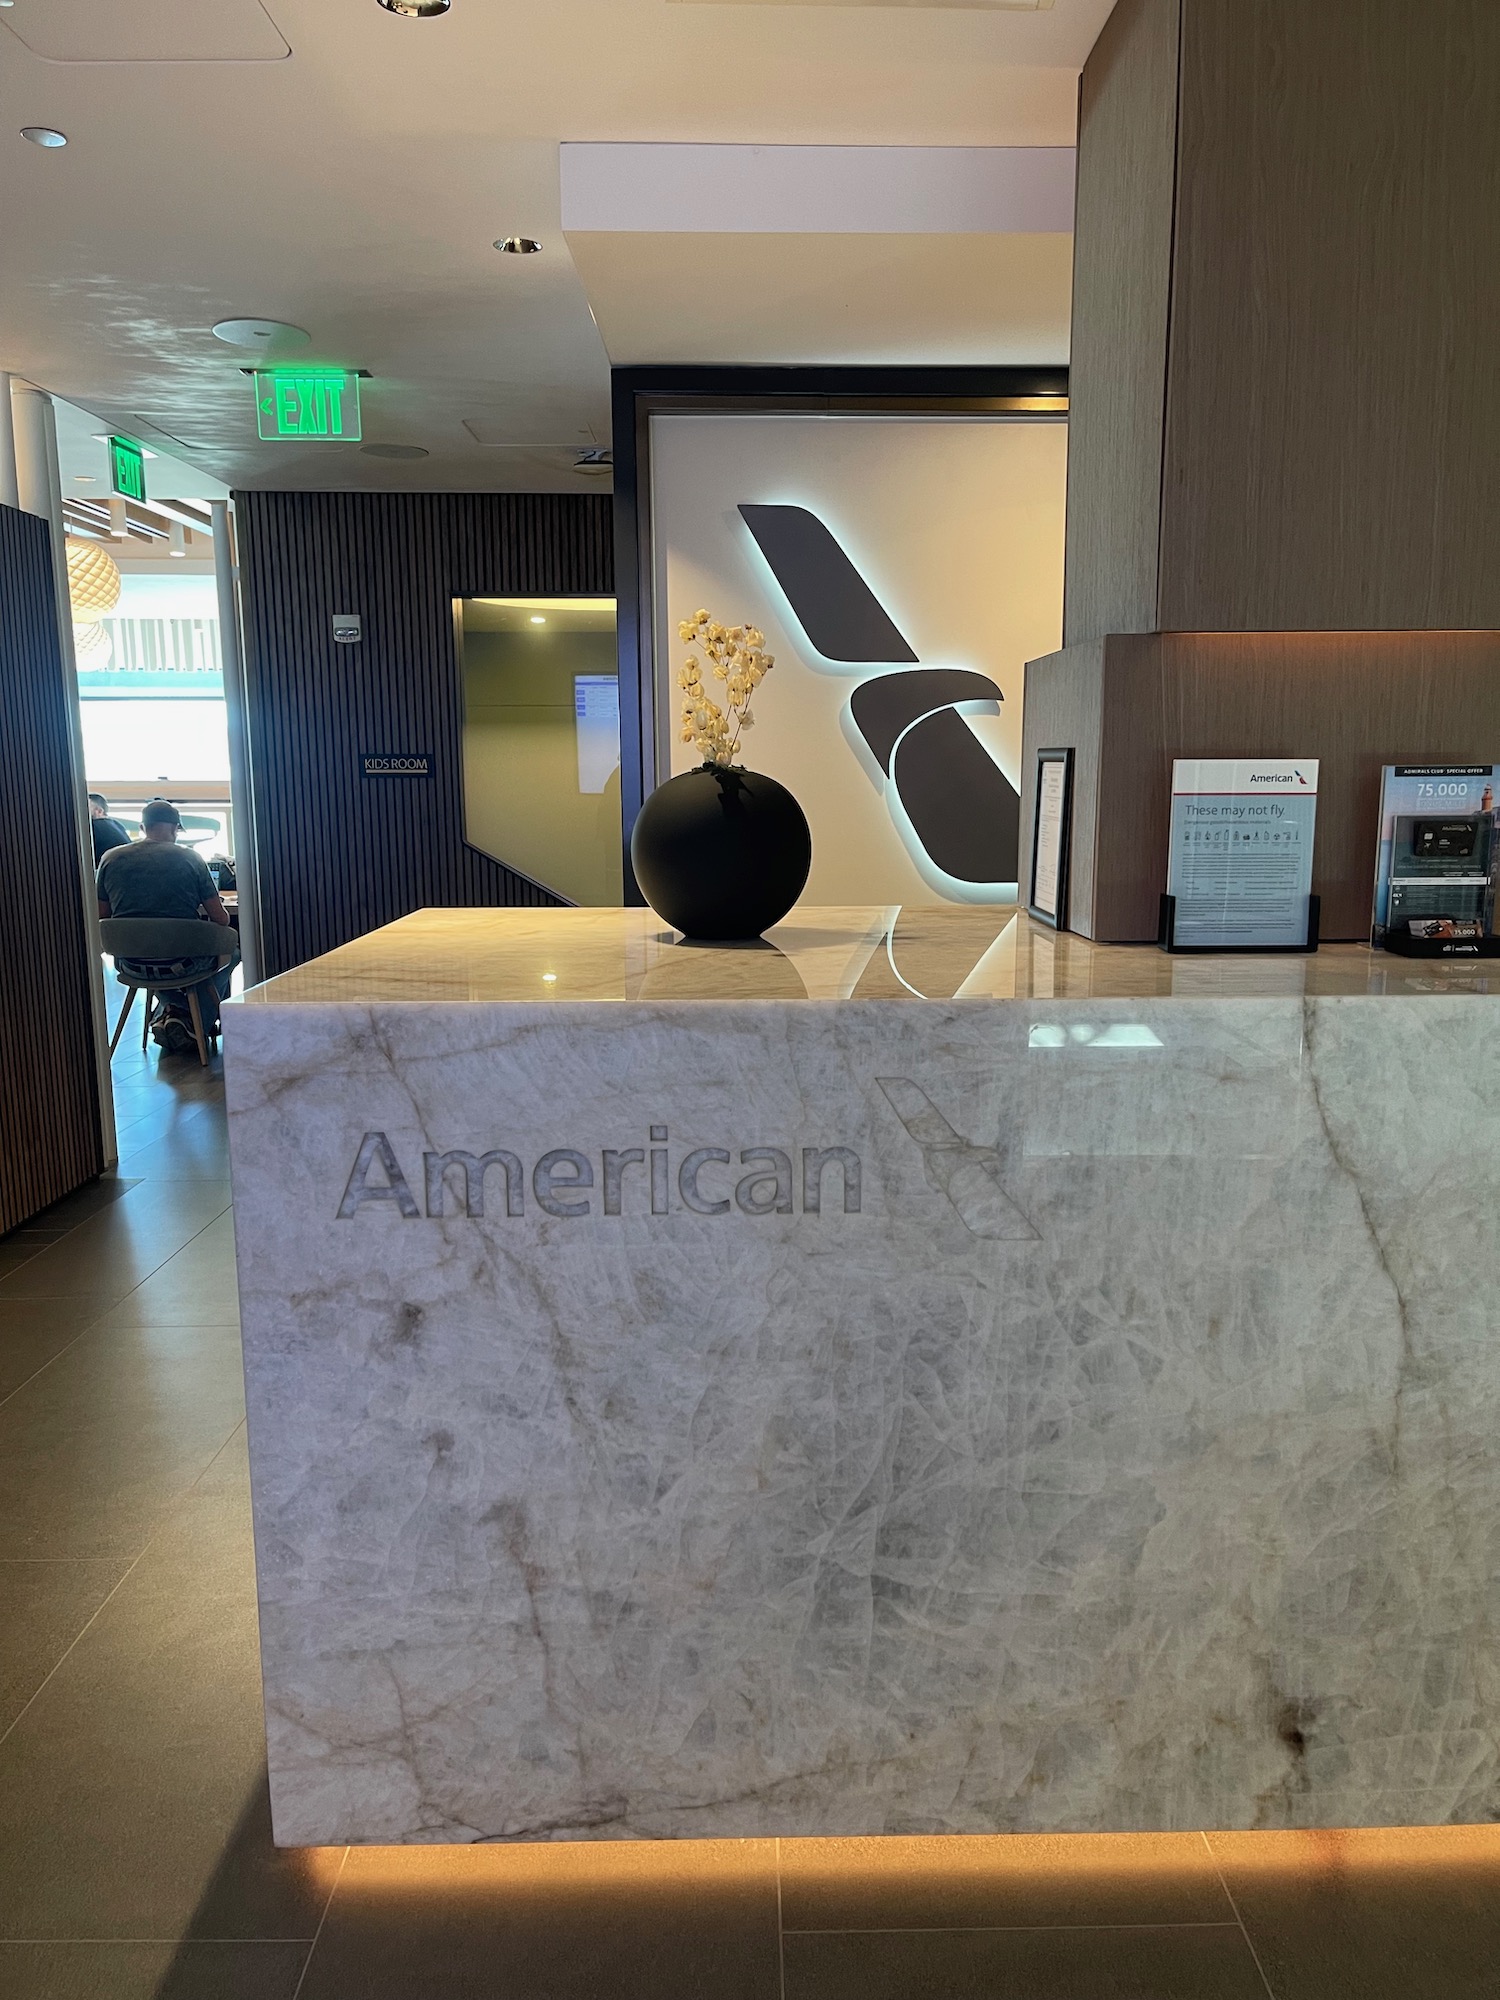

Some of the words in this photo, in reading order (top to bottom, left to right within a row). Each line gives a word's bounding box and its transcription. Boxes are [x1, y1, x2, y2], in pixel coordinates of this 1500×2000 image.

[275, 379, 344, 434] EXIT
[115, 446, 142, 499] EXIT
[364, 758, 390, 769] KIDS
[391, 758, 428, 769] ROOM
[1250, 773, 1293, 783] American
[1417, 783, 1468, 797] 75,000
[1185, 804, 1218, 815] These
[1221, 806, 1246, 818] may
[1248, 805, 1268, 815] not
[1270, 804, 1285, 818] fly
[335, 1125, 862, 1219] American
